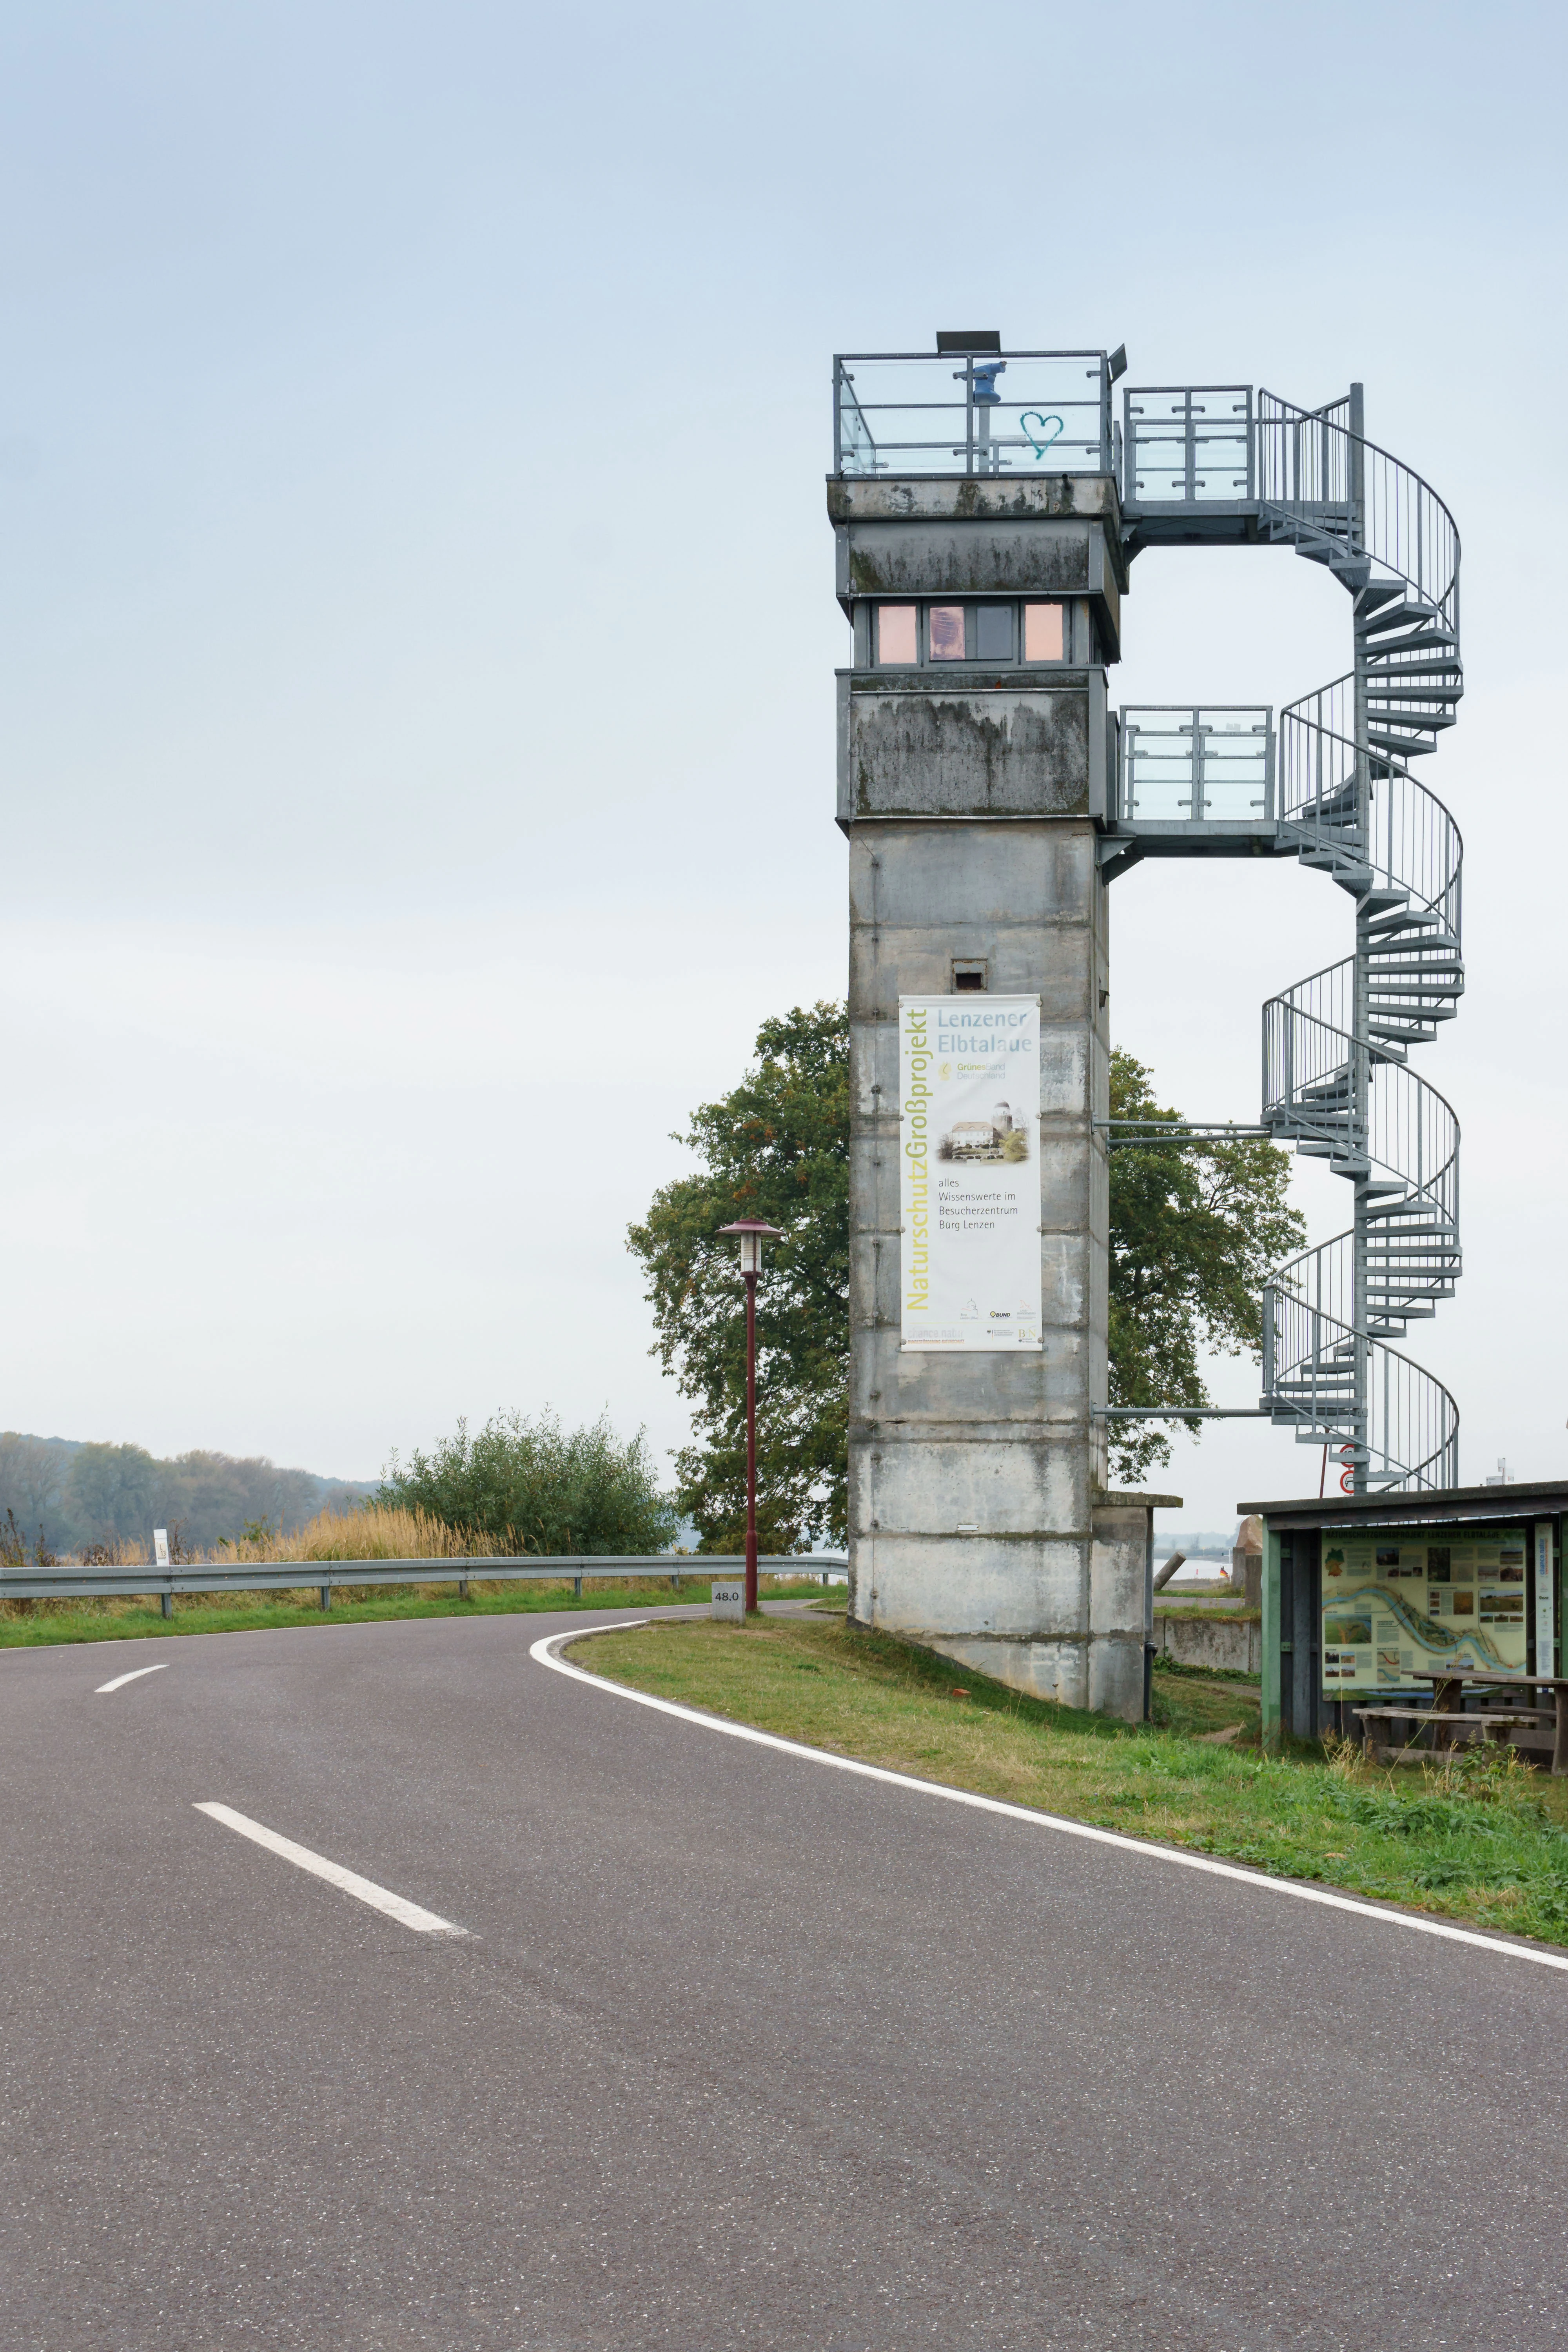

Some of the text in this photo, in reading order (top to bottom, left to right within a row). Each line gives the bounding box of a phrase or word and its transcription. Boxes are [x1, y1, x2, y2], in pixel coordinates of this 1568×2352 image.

[938, 1009, 1027, 1027] Lenzener
[938, 1034, 1032, 1053] Elbtalaue
[905, 1008, 933, 1310] NaturschutzGroßprojekt
[938, 1178, 959, 1187] alles
[939, 1192, 1015, 1201] Wissenswerte im
[939, 1206, 1018, 1215] Besucherzentrum
[939, 1220, 995, 1231] Burg Lenzen
[715, 1592, 739, 1601] 48,0
